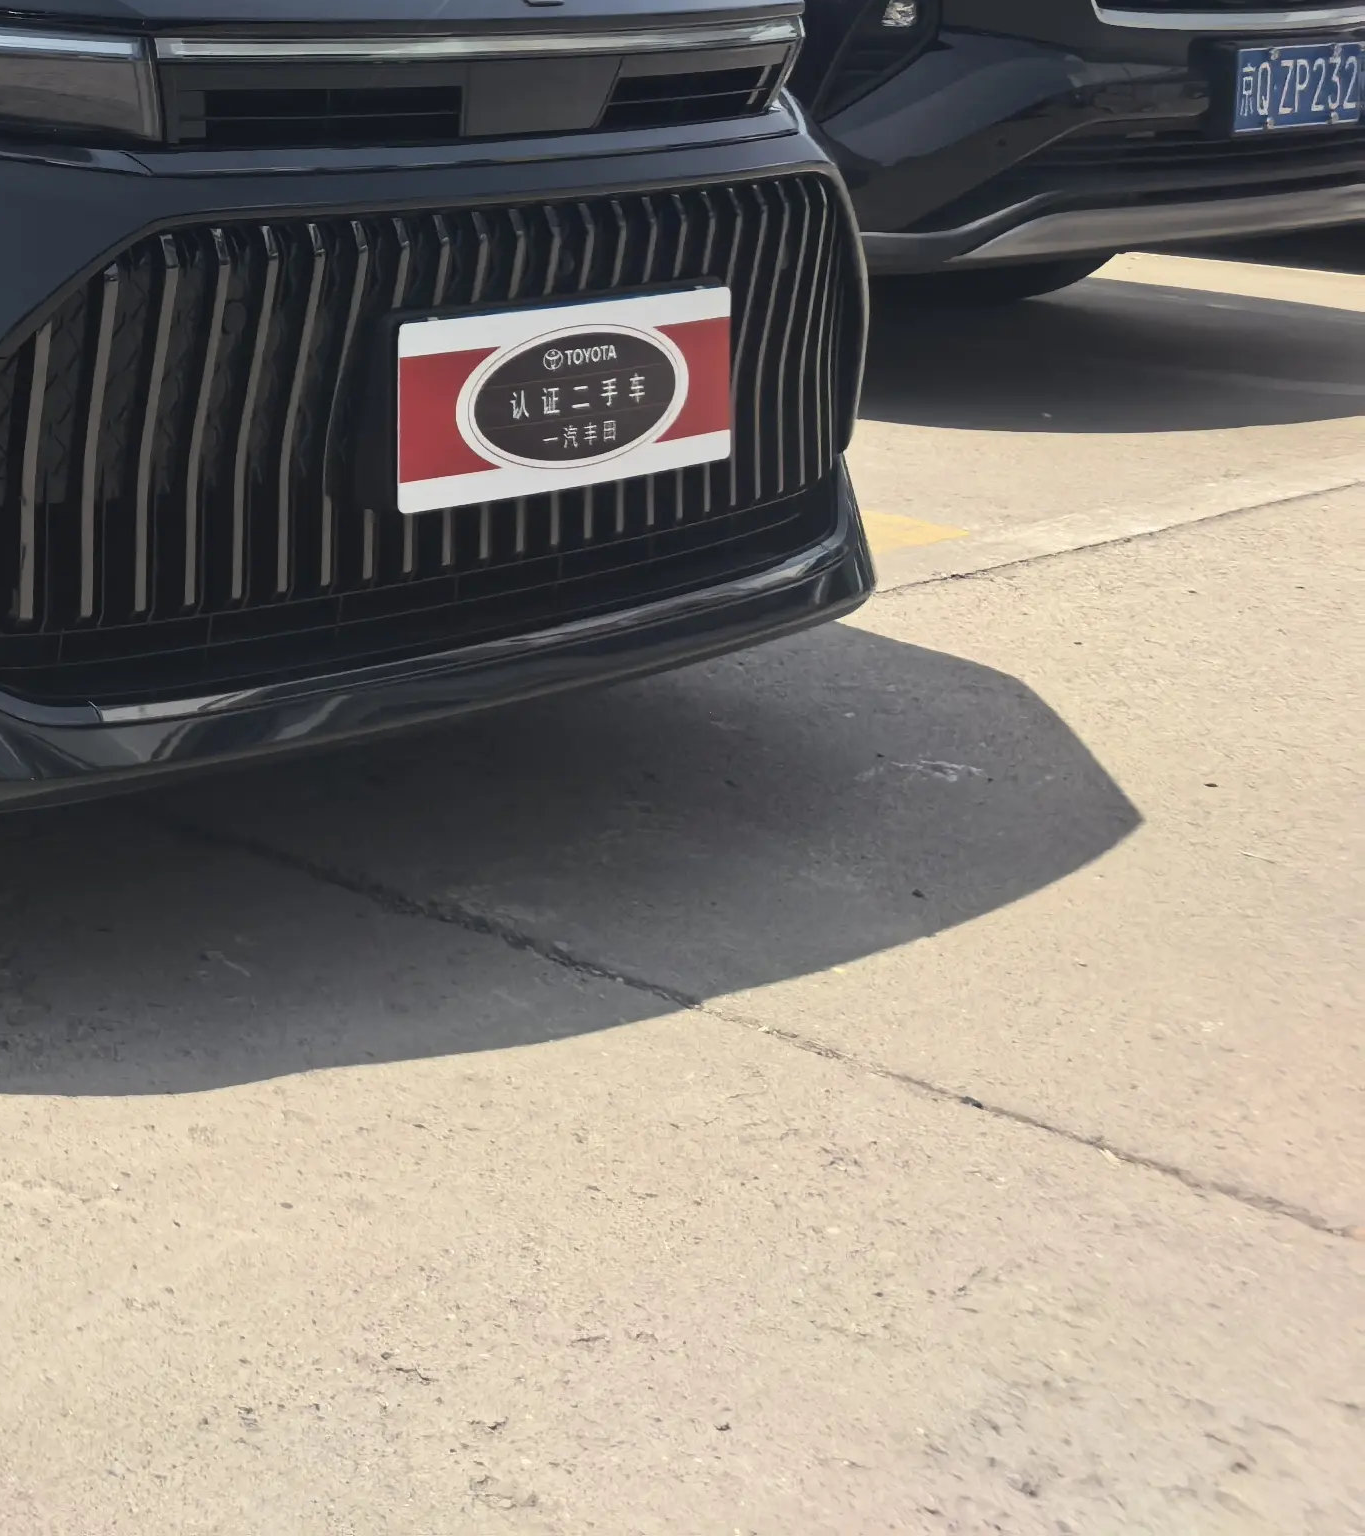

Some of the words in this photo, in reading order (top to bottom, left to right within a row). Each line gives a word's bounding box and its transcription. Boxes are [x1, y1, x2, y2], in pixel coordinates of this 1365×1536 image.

[565, 344, 618, 365] TOYOTA
[509, 372, 646, 420] 认证二手车
